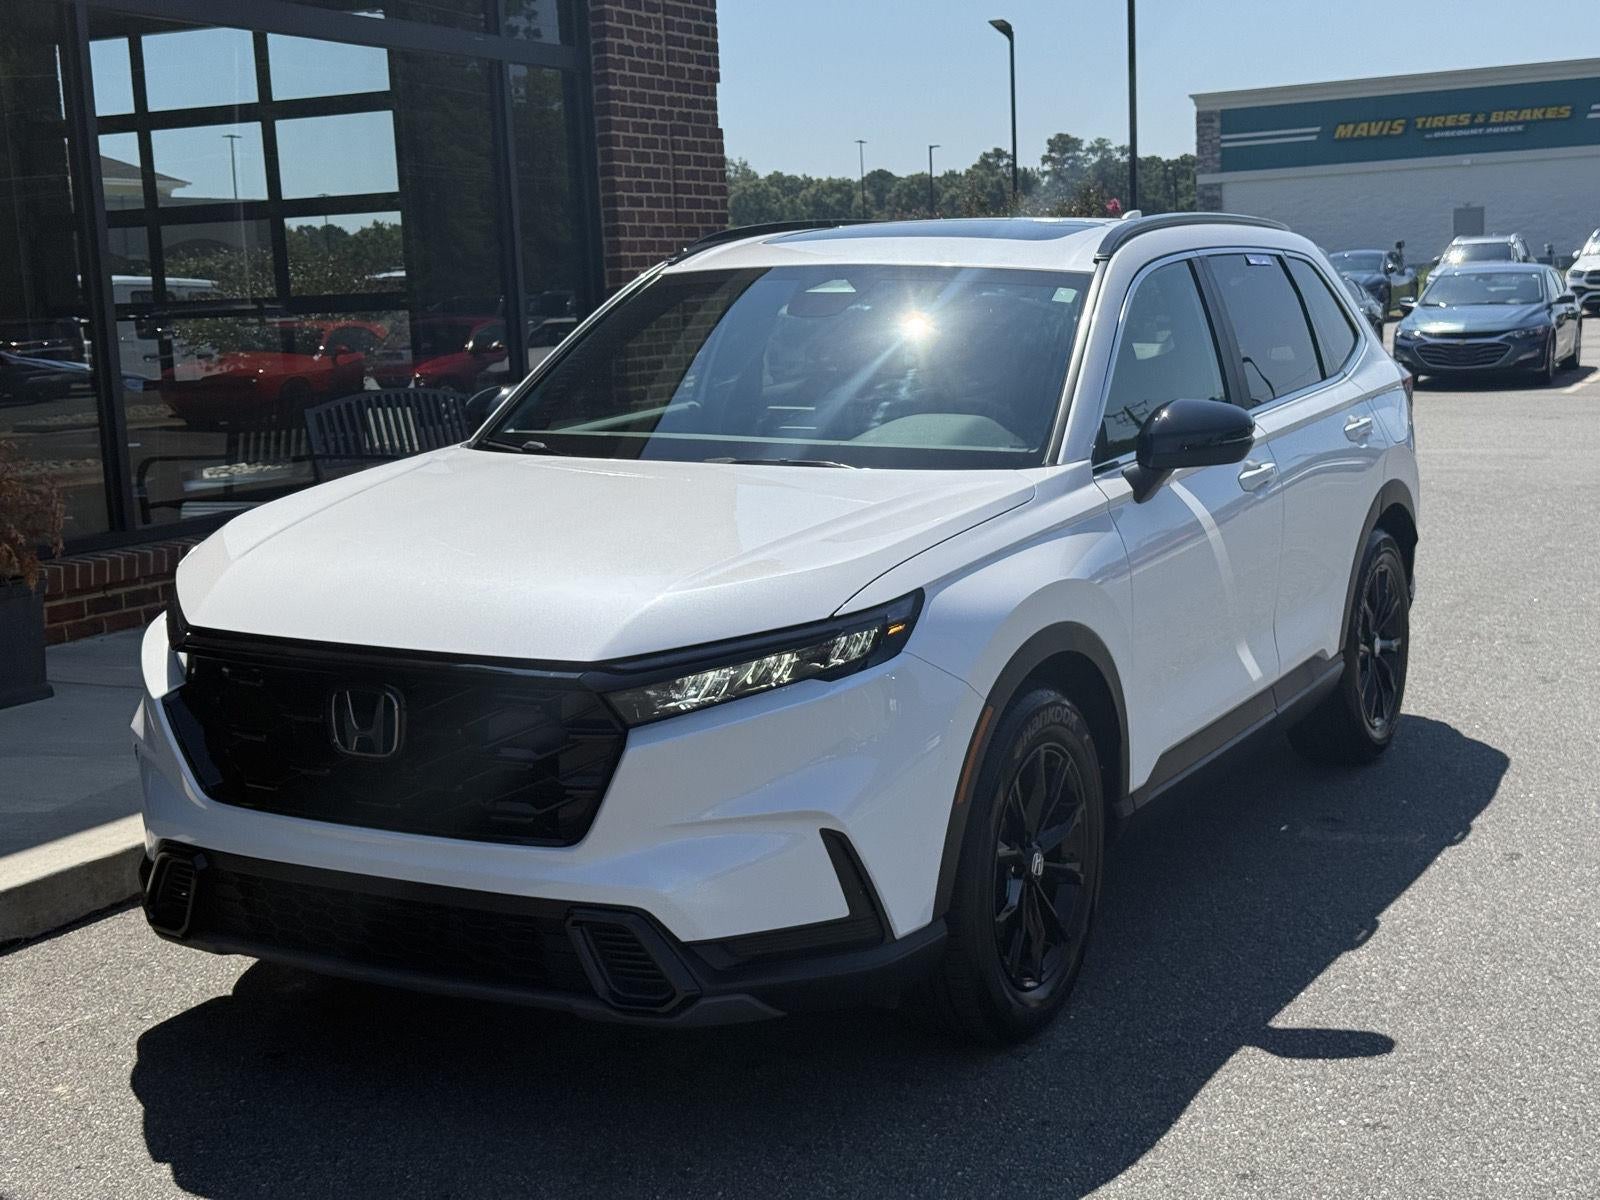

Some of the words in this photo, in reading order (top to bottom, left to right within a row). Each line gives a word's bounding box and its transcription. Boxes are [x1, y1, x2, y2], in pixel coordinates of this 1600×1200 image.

[1335, 119, 1406, 139] MAVIS
[1415, 113, 1471, 128] TIRES
[1474, 112, 1485, 123] &
[1489, 105, 1572, 122] BRAKES
